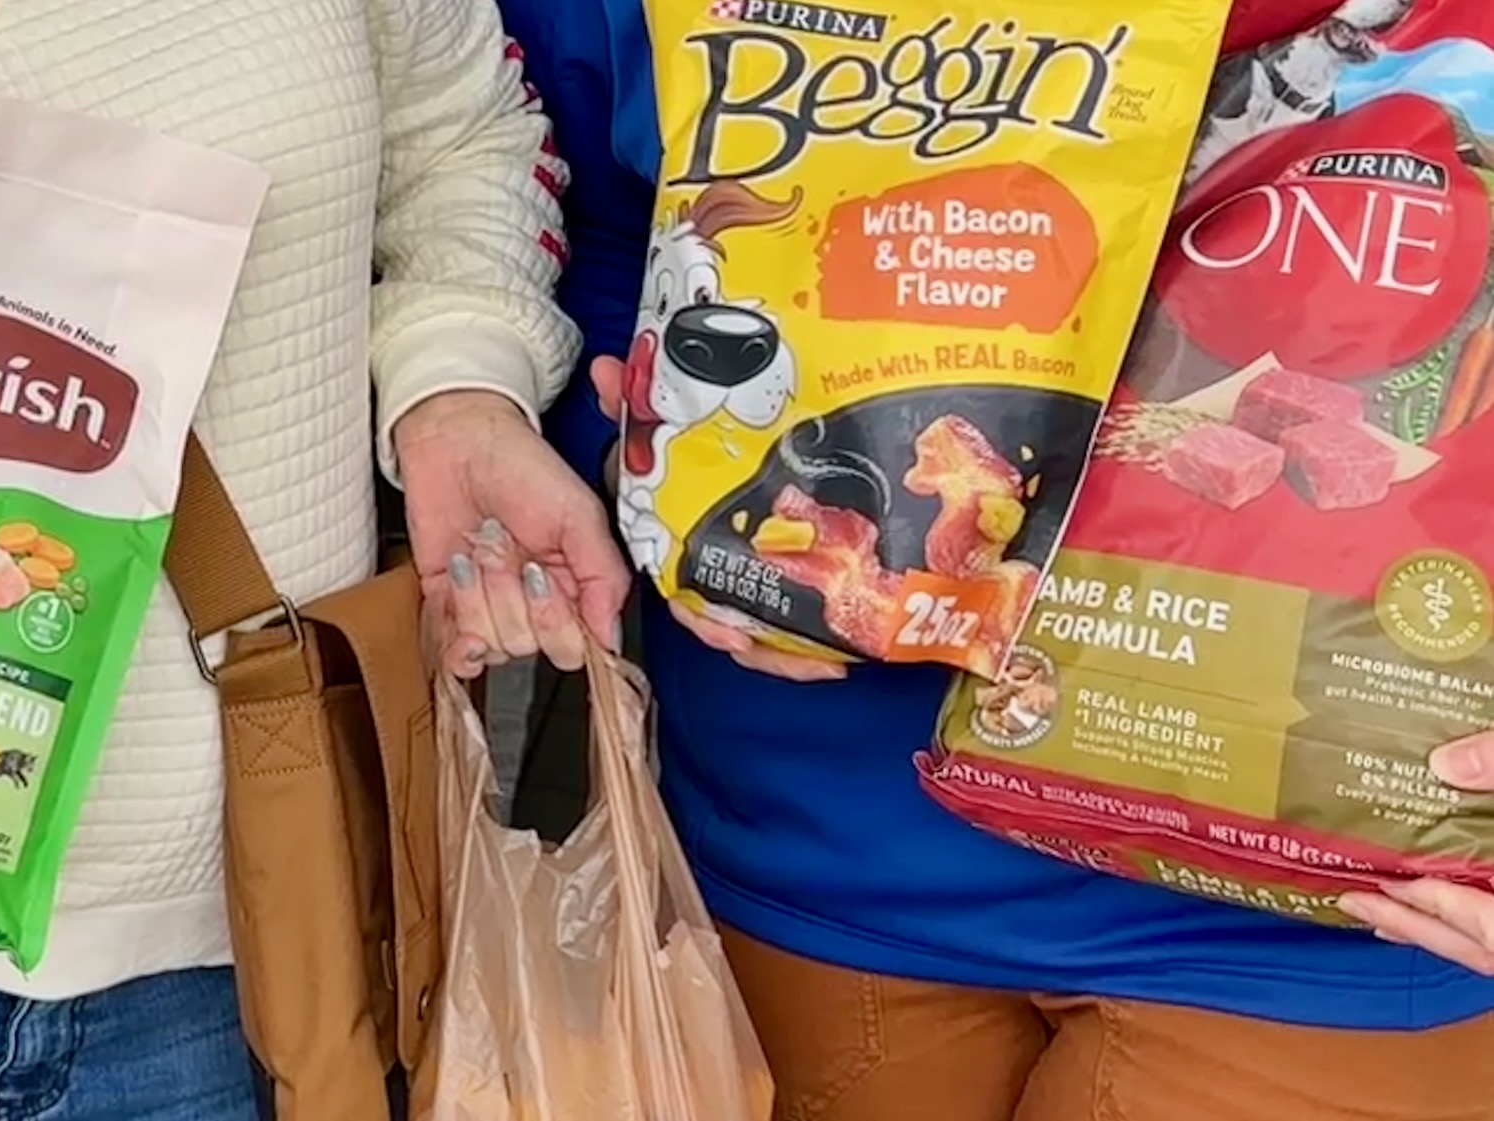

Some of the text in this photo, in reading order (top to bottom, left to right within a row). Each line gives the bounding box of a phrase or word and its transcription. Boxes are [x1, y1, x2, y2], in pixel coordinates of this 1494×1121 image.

[664, 17, 1129, 187] Beggin'
[1313, 154, 1441, 185] PURINA
[862, 200, 1053, 237] With Bacon
[875, 237, 1037, 273] & Cheese
[1180, 183, 1443, 296] ONE
[896, 273, 1008, 310] Flavor
[58, 317, 73, 334] in
[73, 328, 118, 357] Need.
[820, 342, 1077, 395] Made With REAL Bacon
[707, 568, 726, 592] LB
[725, 554, 749, 577] WT
[1389, 558, 1483, 615] VETERINARIAN
[1113, 584, 1136, 615] &
[1145, 588, 1232, 633] RICE
[1387, 603, 1482, 651] RECOMMENDED
[1034, 610, 1197, 666] FORMULA
[1331, 652, 1436, 687] MICROBIOME
[1365, 676, 1426, 700] Prebiotic
[1077, 687, 1198, 728] REAL LAMB
[1324, 685, 1348, 699] gut
[1350, 687, 1394, 706] health
[1073, 726, 1130, 749] Supports
[1132, 737, 1174, 761] Strong
[1096, 712, 1226, 754] INGREDIENT
[1072, 740, 1128, 763] Including
[1142, 755, 1191, 776] Healthy
[1193, 766, 1231, 784] Heart
[1345, 750, 1388, 772] 100%
[1335, 783, 1375, 804] Every
[1360, 771, 1461, 805] 0% FILLERS
[1209, 823, 1238, 845] NET
[1239, 831, 1267, 851] WT
[1268, 834, 1281, 854] 8
[1281, 836, 1303, 860] LB
